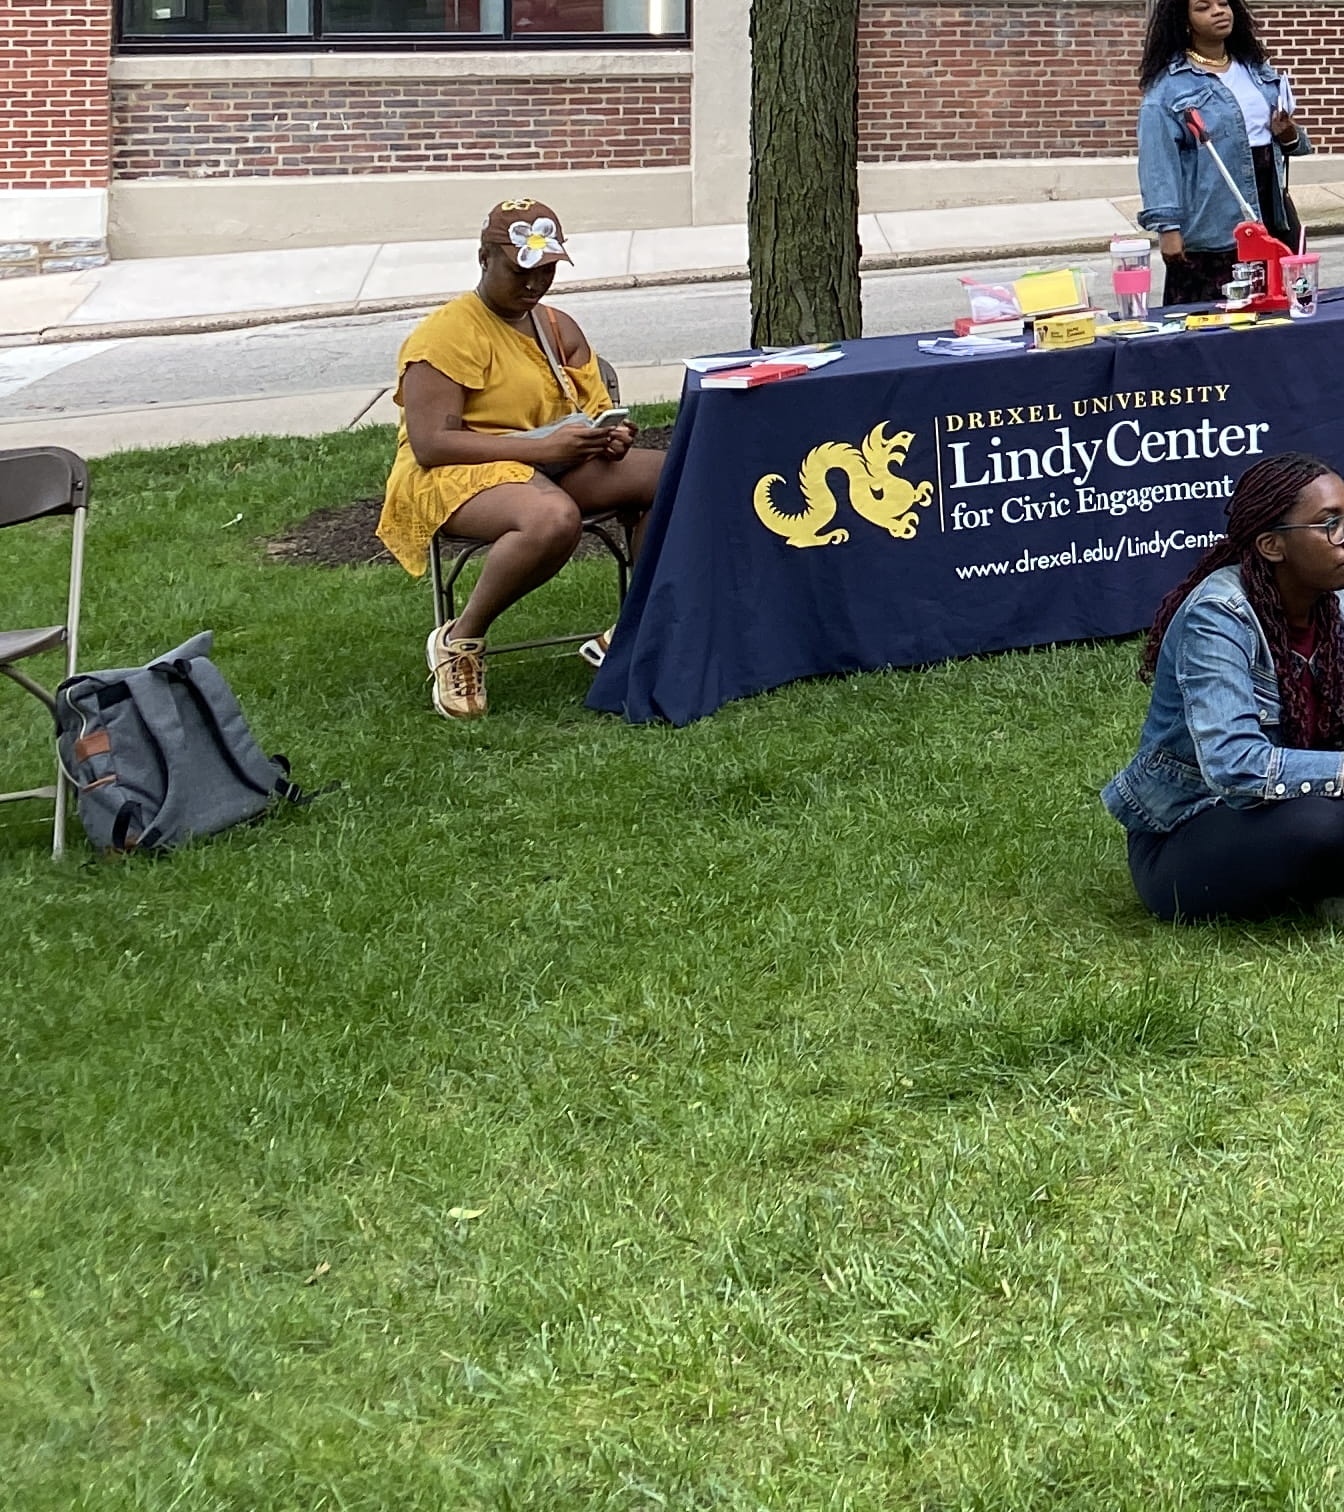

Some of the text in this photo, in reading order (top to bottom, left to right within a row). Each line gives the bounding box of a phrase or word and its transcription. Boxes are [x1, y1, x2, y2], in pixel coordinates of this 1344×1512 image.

[945, 384, 1230, 432] DREXEL UNIVERSITY
[951, 474, 1235, 530] for Civic Engagement
[956, 529, 1229, 580] www.drexel.edu/LindyCente
